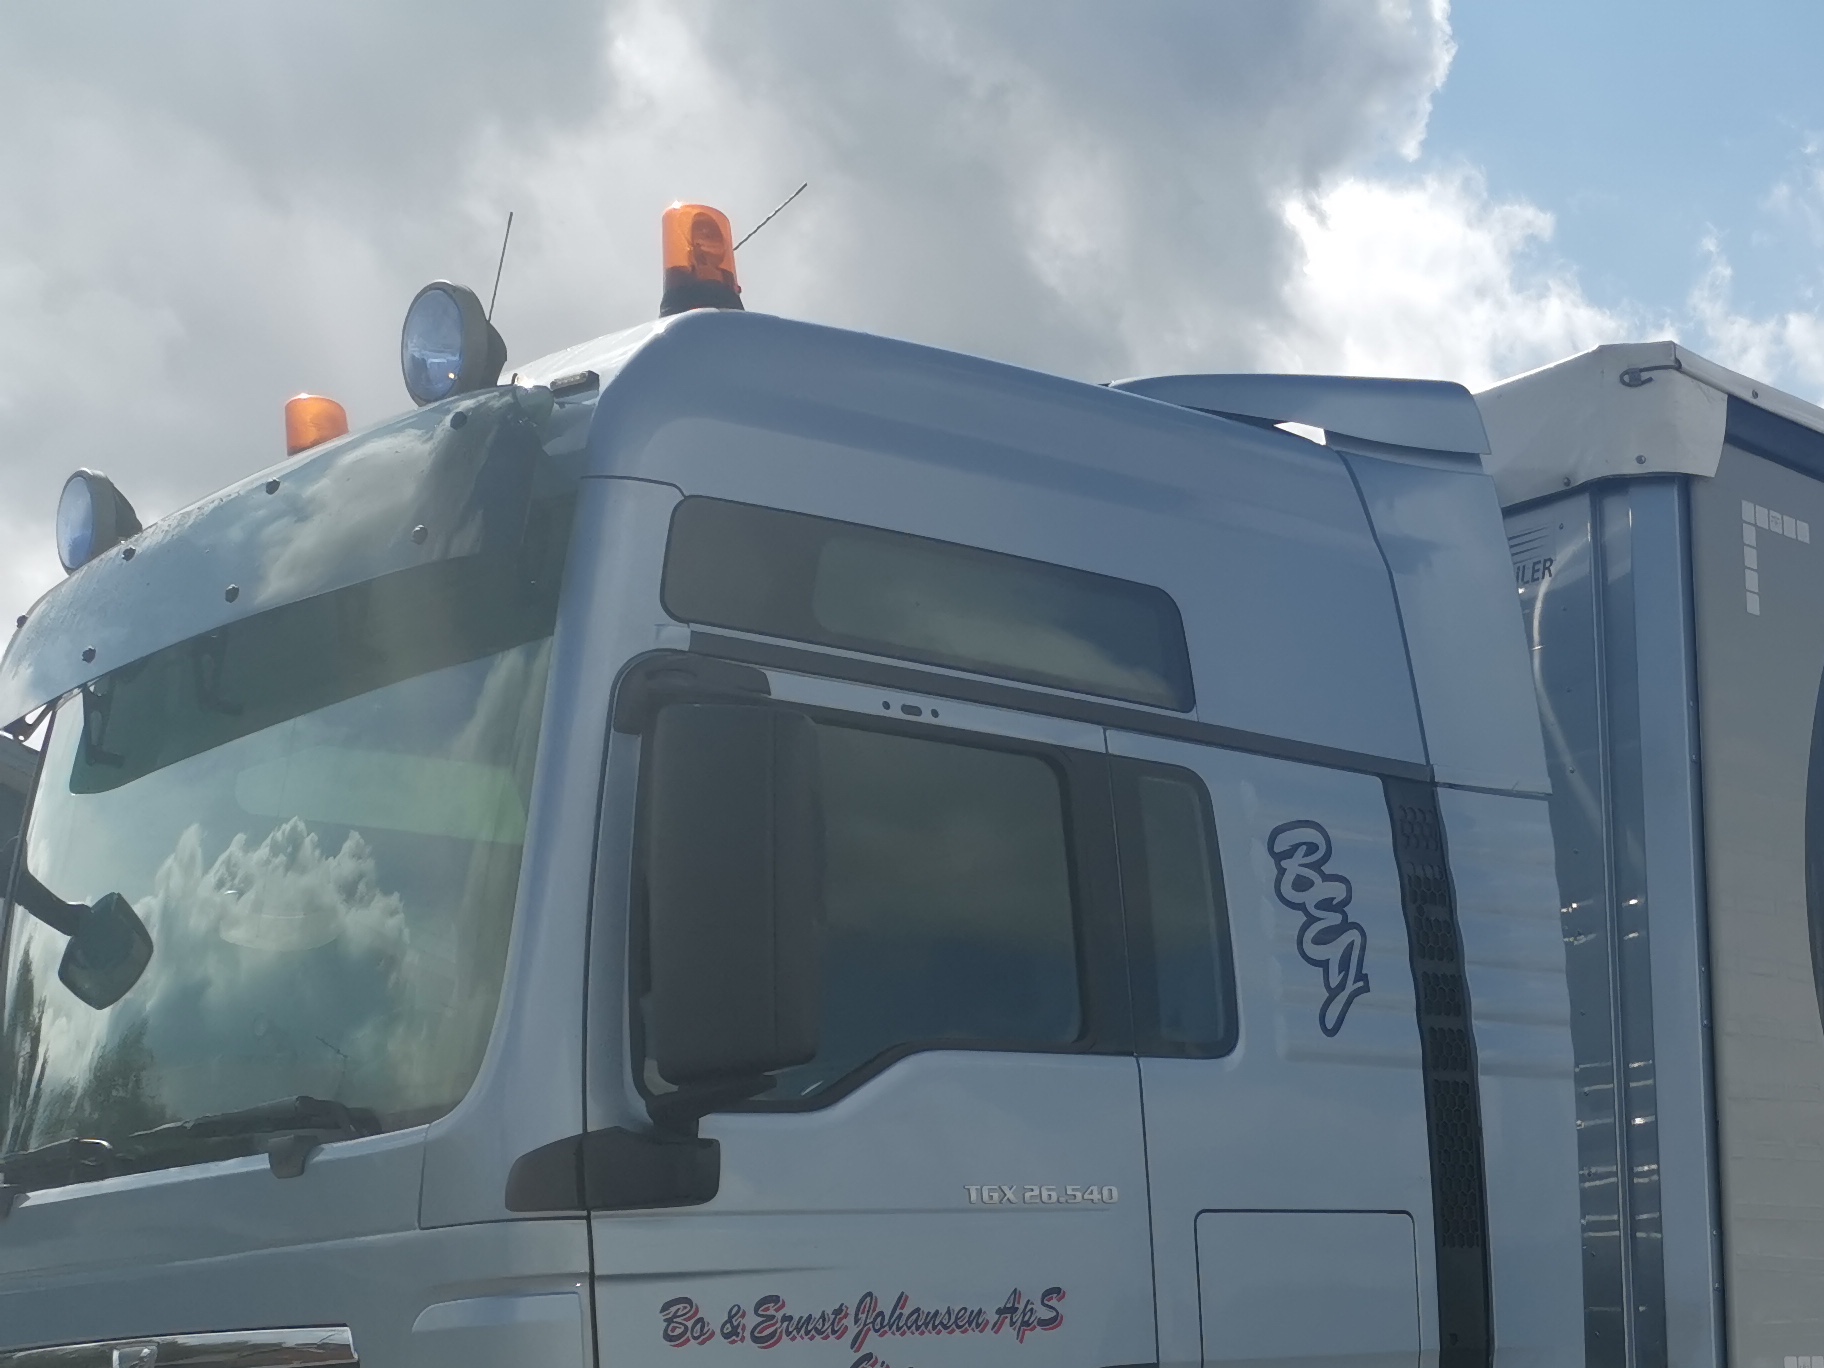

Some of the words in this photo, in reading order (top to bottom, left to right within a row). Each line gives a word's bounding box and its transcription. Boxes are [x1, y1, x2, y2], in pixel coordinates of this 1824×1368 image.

[1516, 557, 1554, 585] ILER
[963, 1184, 1019, 1205] TGX
[1023, 1184, 1119, 1205] 26.540
[659, 1296, 715, 1348] Bo
[719, 1303, 746, 1345] &
[749, 1294, 849, 1349] Ernst
[849, 1290, 991, 1353] Johansen
[991, 1286, 1066, 1344] ApS
